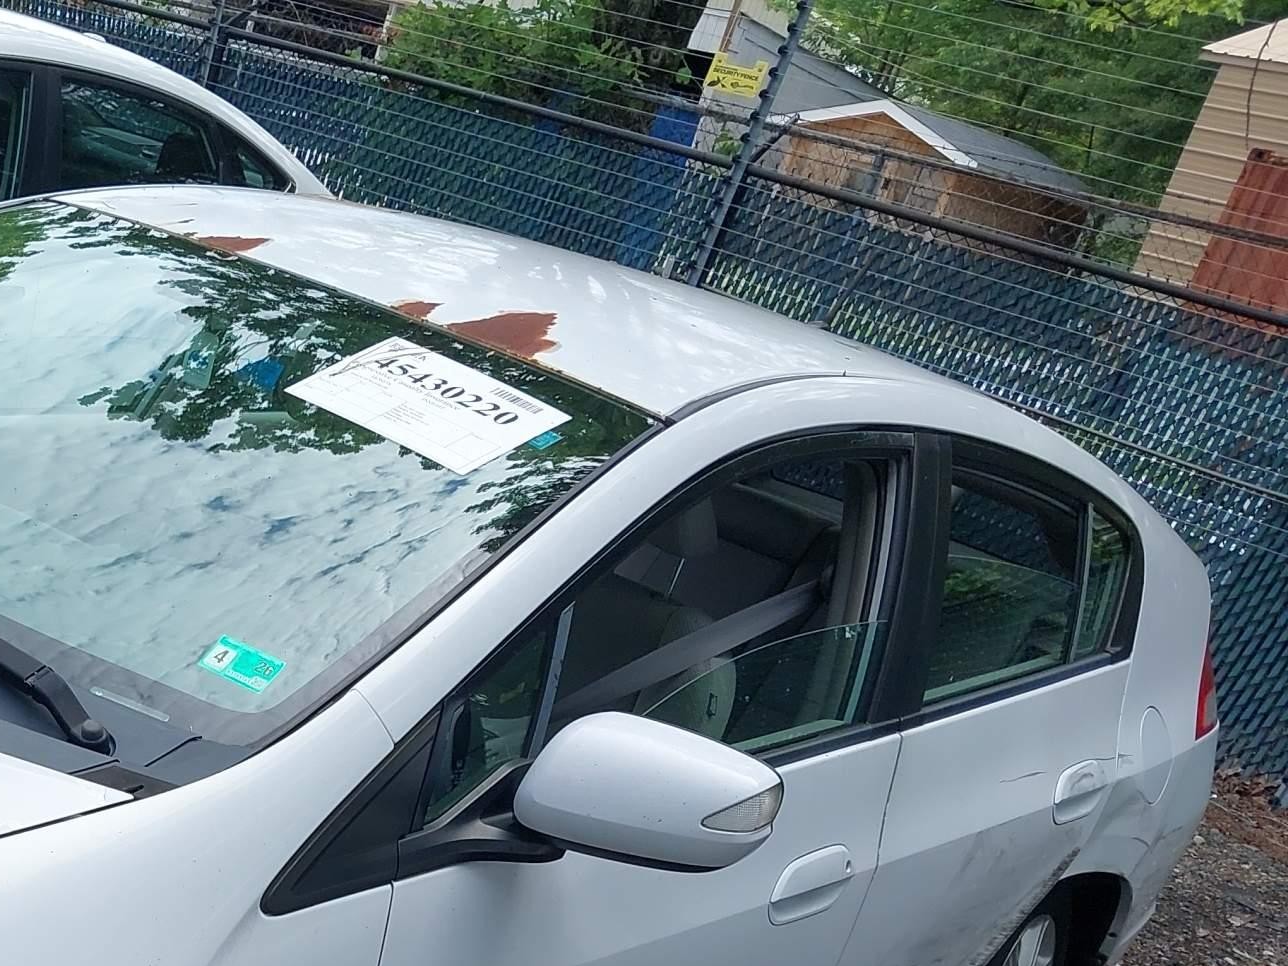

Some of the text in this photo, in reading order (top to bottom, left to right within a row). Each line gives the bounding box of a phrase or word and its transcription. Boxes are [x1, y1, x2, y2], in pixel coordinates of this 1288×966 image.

[713, 67, 739, 77] SECURITY
[740, 72, 760, 81] FENCE
[374, 357, 519, 425] 45430220
[213, 649, 230, 664] 4
